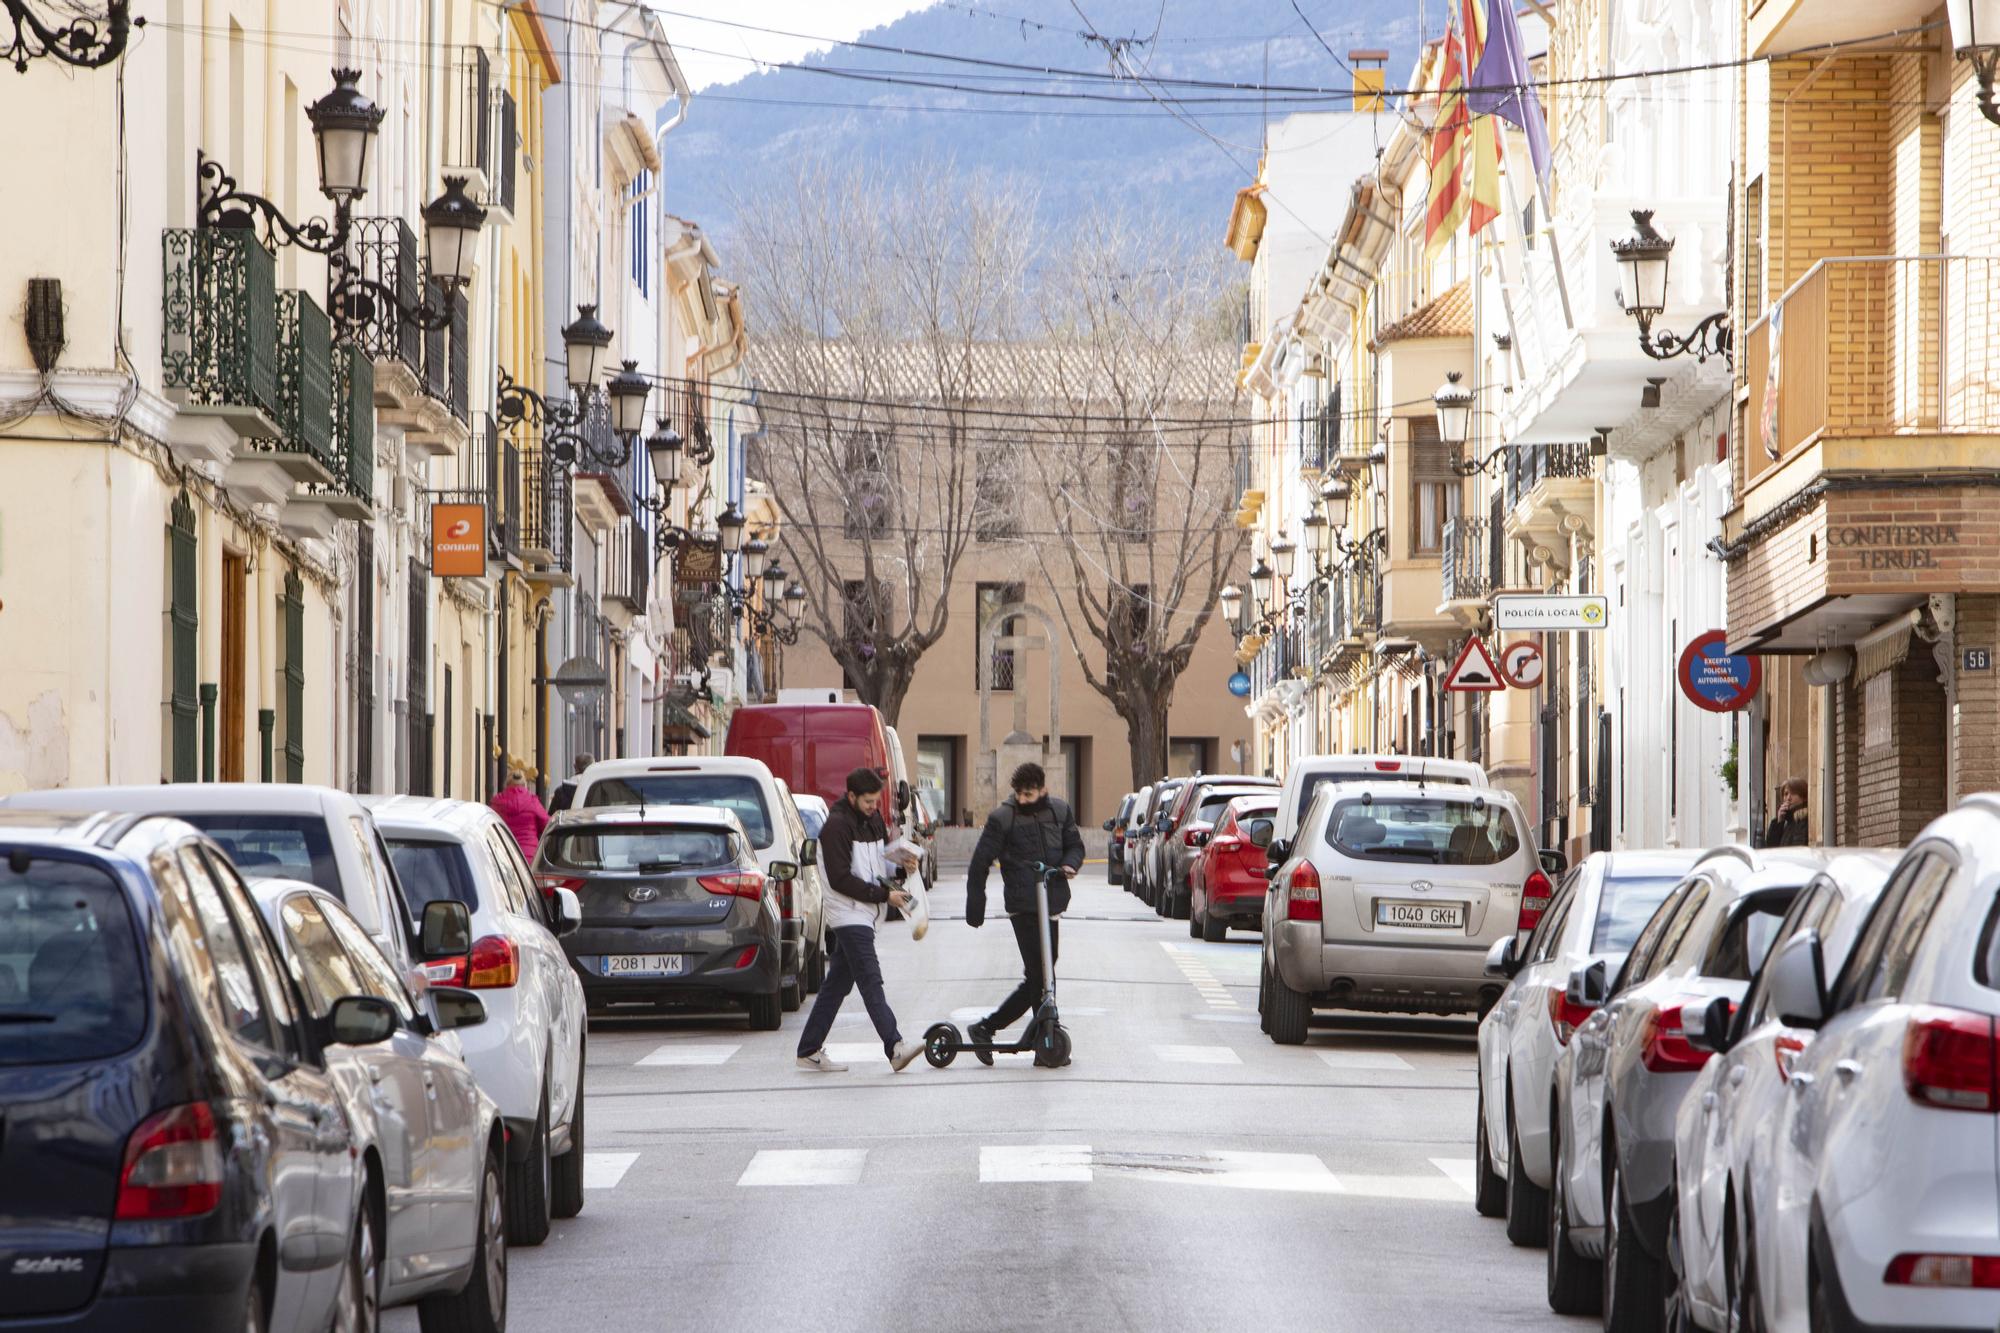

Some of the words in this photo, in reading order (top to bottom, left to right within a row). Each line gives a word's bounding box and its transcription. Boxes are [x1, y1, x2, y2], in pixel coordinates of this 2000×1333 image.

[1826, 525, 1959, 546] CONFITERIA
[1857, 550, 1938, 569] TERUEL
[1504, 606, 1544, 617] POLICÍA
[1548, 608, 1580, 617] LOCAL
[1704, 657, 1731, 665] EXCEPTO
[1969, 651, 1985, 668] 56
[1697, 676, 1739, 685] AUTORIDADES
[1391, 906, 1424, 921] 1040
[1430, 908, 1456, 924] GKH
[612, 957, 646, 970] 2081
[653, 957, 679, 970] JVK
